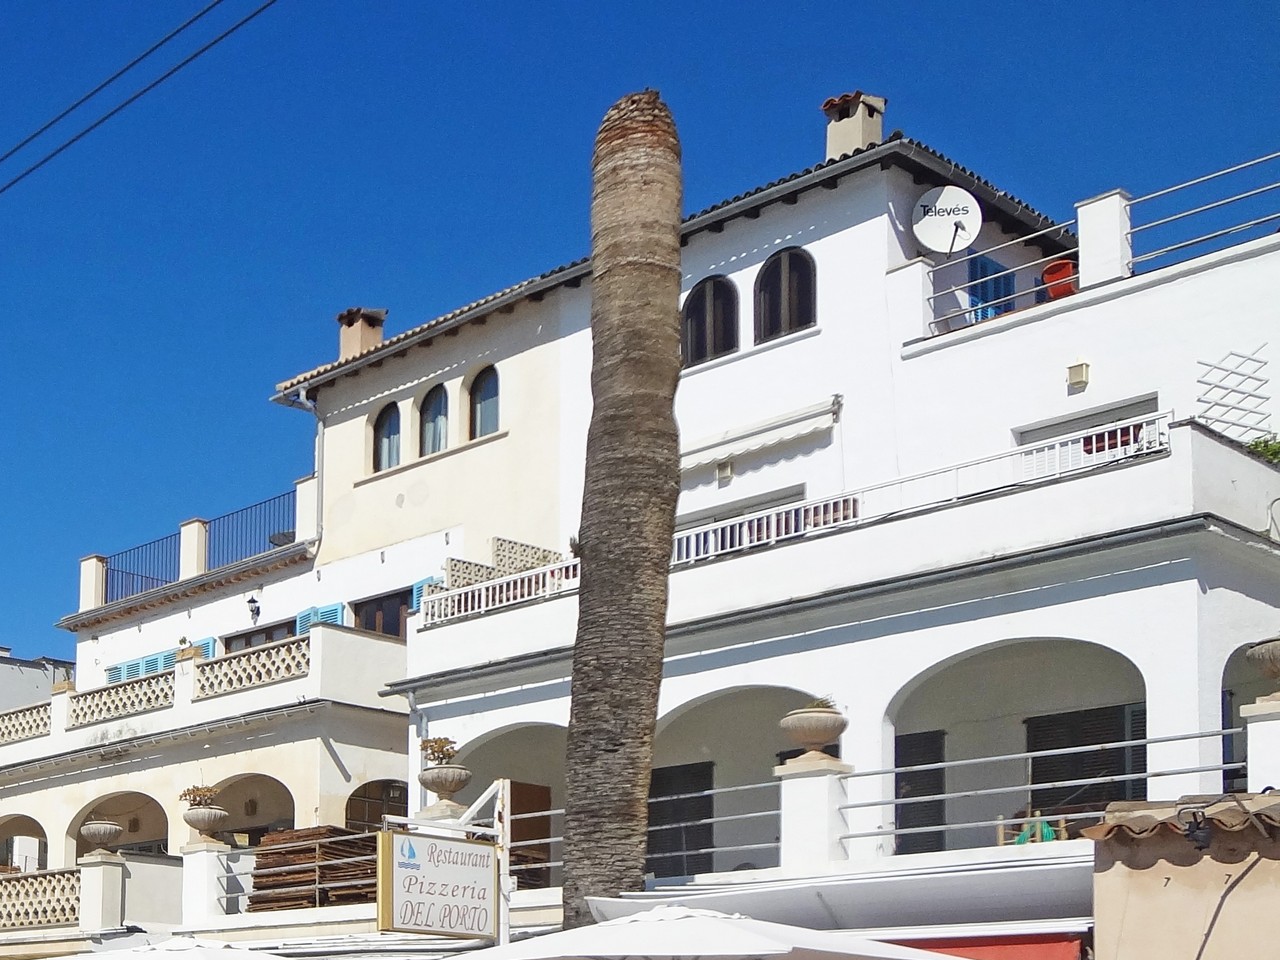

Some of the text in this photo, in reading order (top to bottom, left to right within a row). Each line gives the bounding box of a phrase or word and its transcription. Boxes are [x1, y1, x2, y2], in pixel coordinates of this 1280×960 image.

[920, 203, 970, 217] Televés
[427, 842, 491, 868] Restaurant
[402, 874, 487, 900] Pizzeria
[400, 900, 488, 932] DEL PORTO
